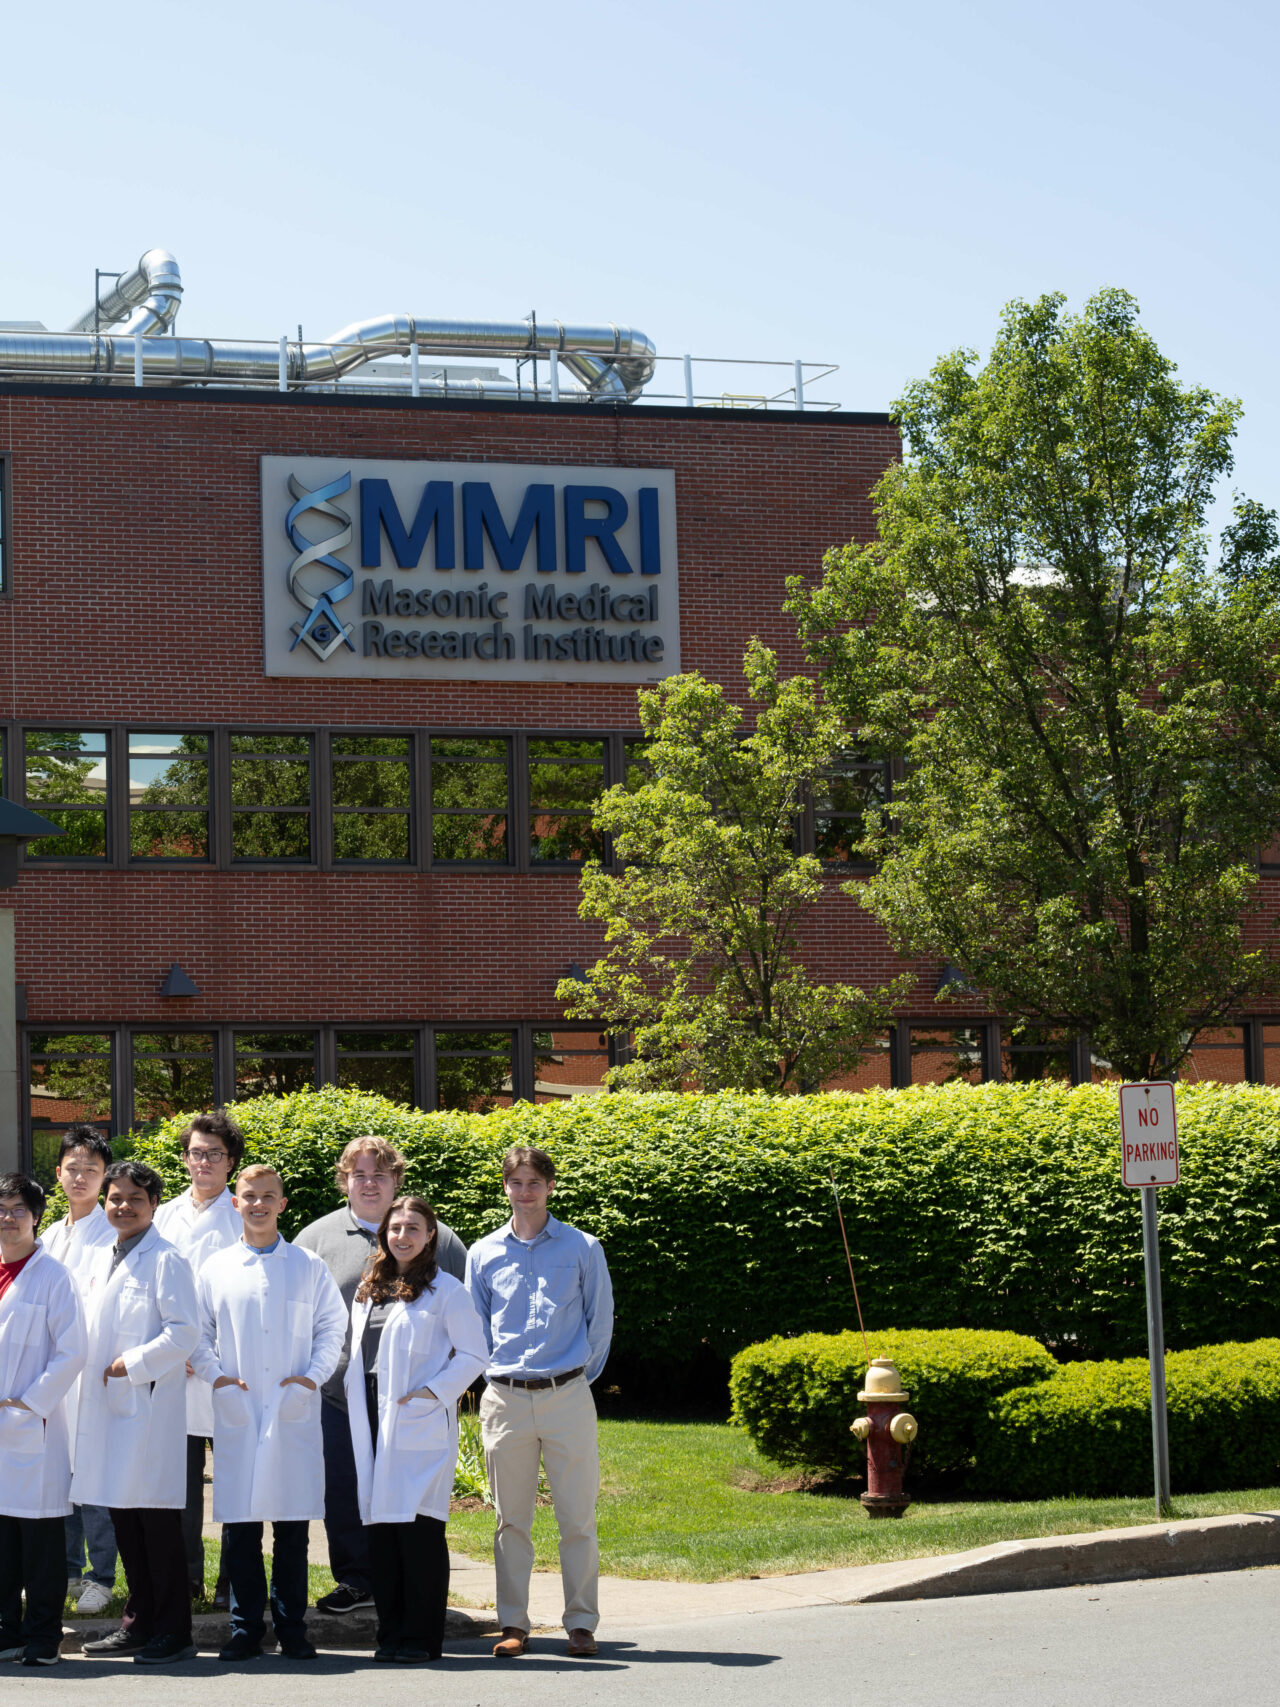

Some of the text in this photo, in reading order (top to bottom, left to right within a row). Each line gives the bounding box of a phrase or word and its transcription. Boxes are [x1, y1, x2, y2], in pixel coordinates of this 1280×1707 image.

[359, 478, 661, 575] MMRI
[361, 578, 659, 622] Masonic Medical
[362, 620, 665, 663] Research Institute
[1138, 1108, 1159, 1127] NO
[1126, 1141, 1175, 1163] PARKING
